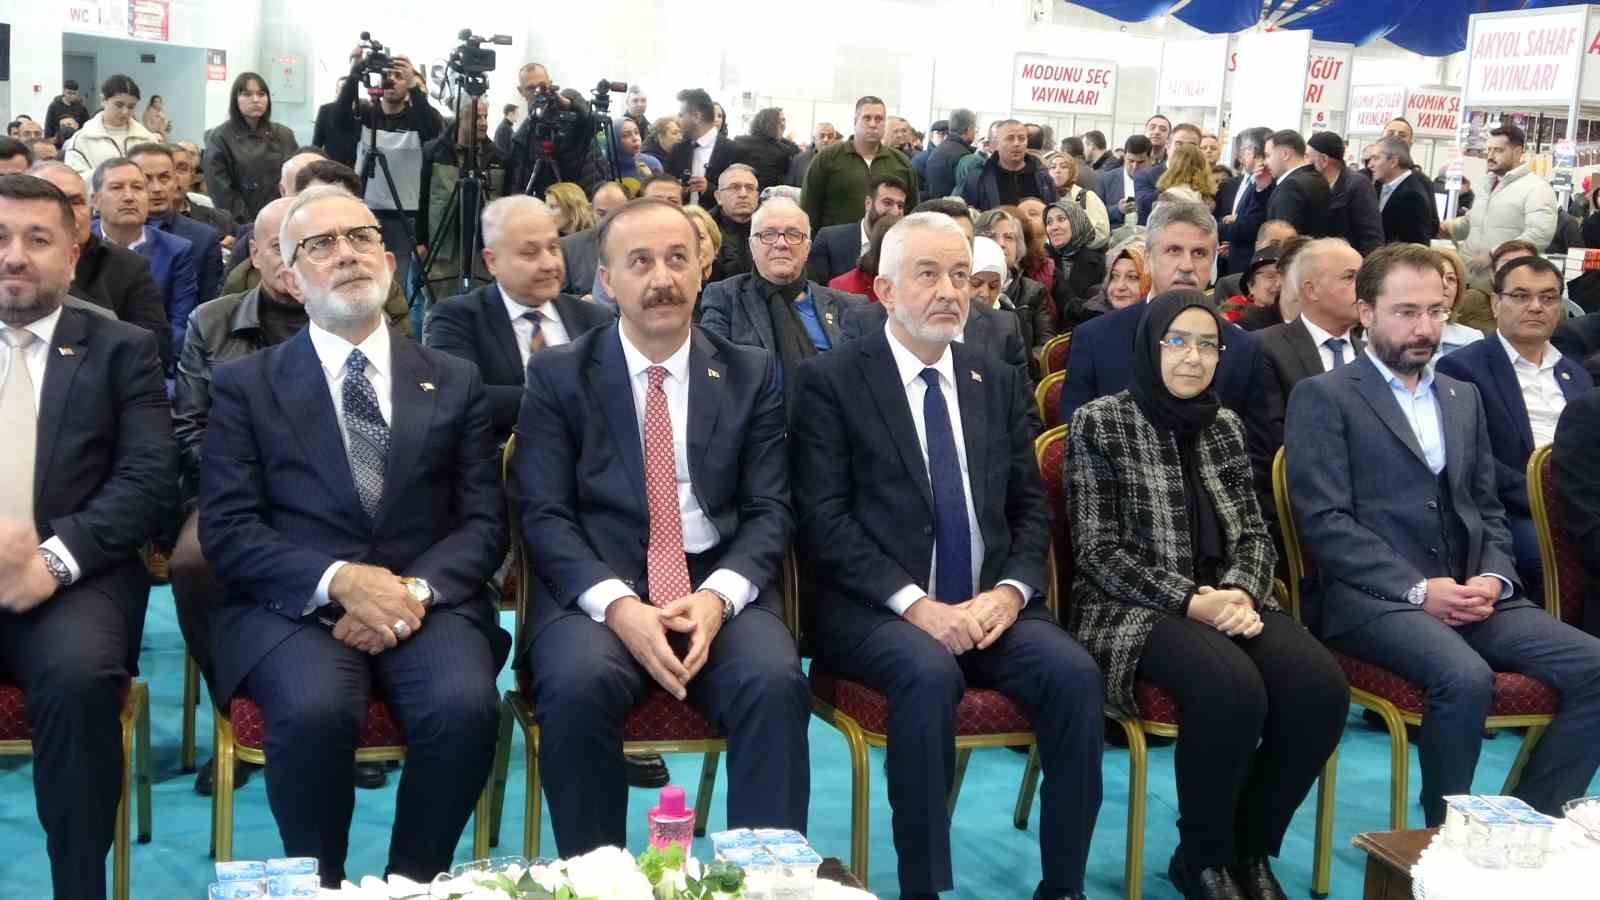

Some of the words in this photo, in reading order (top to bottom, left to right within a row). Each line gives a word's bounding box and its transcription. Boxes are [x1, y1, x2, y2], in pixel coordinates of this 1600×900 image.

[1473, 31, 1520, 60] AKYOL
[1523, 26, 1577, 56] SAHAF
[1022, 63, 1083, 83] MODUNU
[1086, 67, 1112, 88] SEÇ
[1308, 55, 1343, 80] ĞÜT
[1481, 64, 1559, 92] YAYINLARI
[1031, 86, 1099, 107] YAYINLARI
